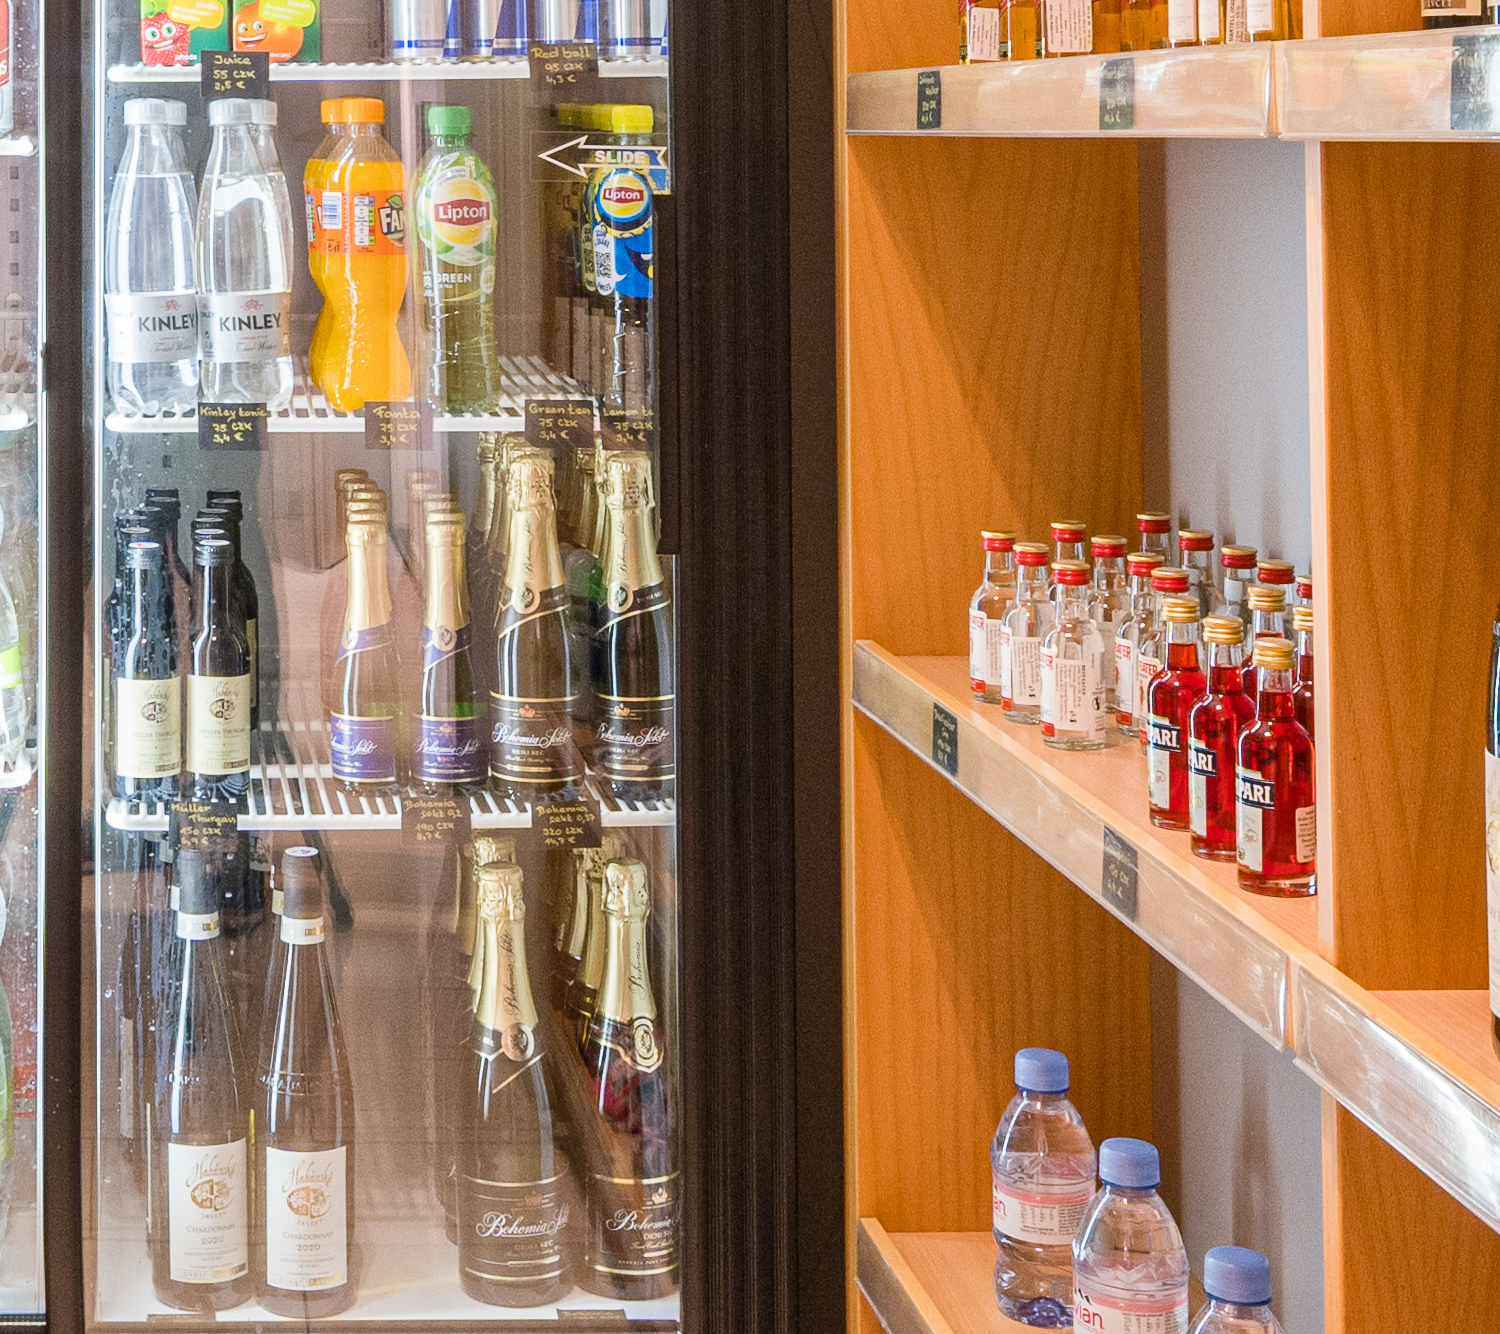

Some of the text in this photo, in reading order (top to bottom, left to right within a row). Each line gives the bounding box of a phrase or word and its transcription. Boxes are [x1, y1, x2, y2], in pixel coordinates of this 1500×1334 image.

[214, 54, 252, 67] Juice
[595, 150, 647, 165] SLIDE
[604, 188, 641, 200] Lipton
[438, 202, 488, 221] Lipton
[138, 314, 196, 332] KINLEY
[220, 313, 281, 332] KINLEY
